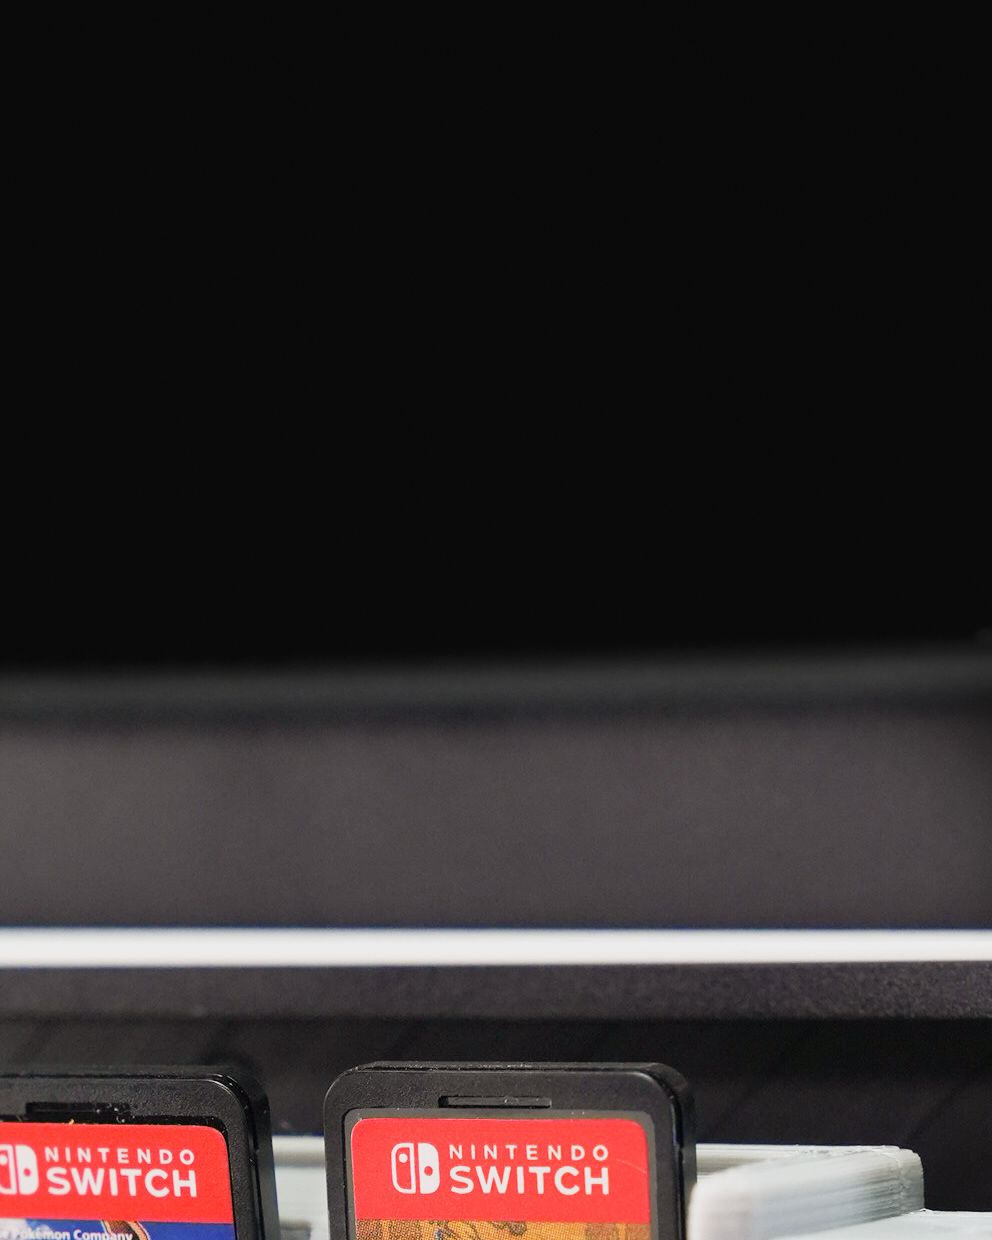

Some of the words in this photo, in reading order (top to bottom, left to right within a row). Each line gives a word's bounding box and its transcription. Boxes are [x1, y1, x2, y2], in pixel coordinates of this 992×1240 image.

[45, 1146, 195, 1165] NINTENDO
[449, 1143, 609, 1162] NINTENDO
[46, 1167, 198, 1198] SWITCH
[449, 1165, 610, 1196] SWITCH
